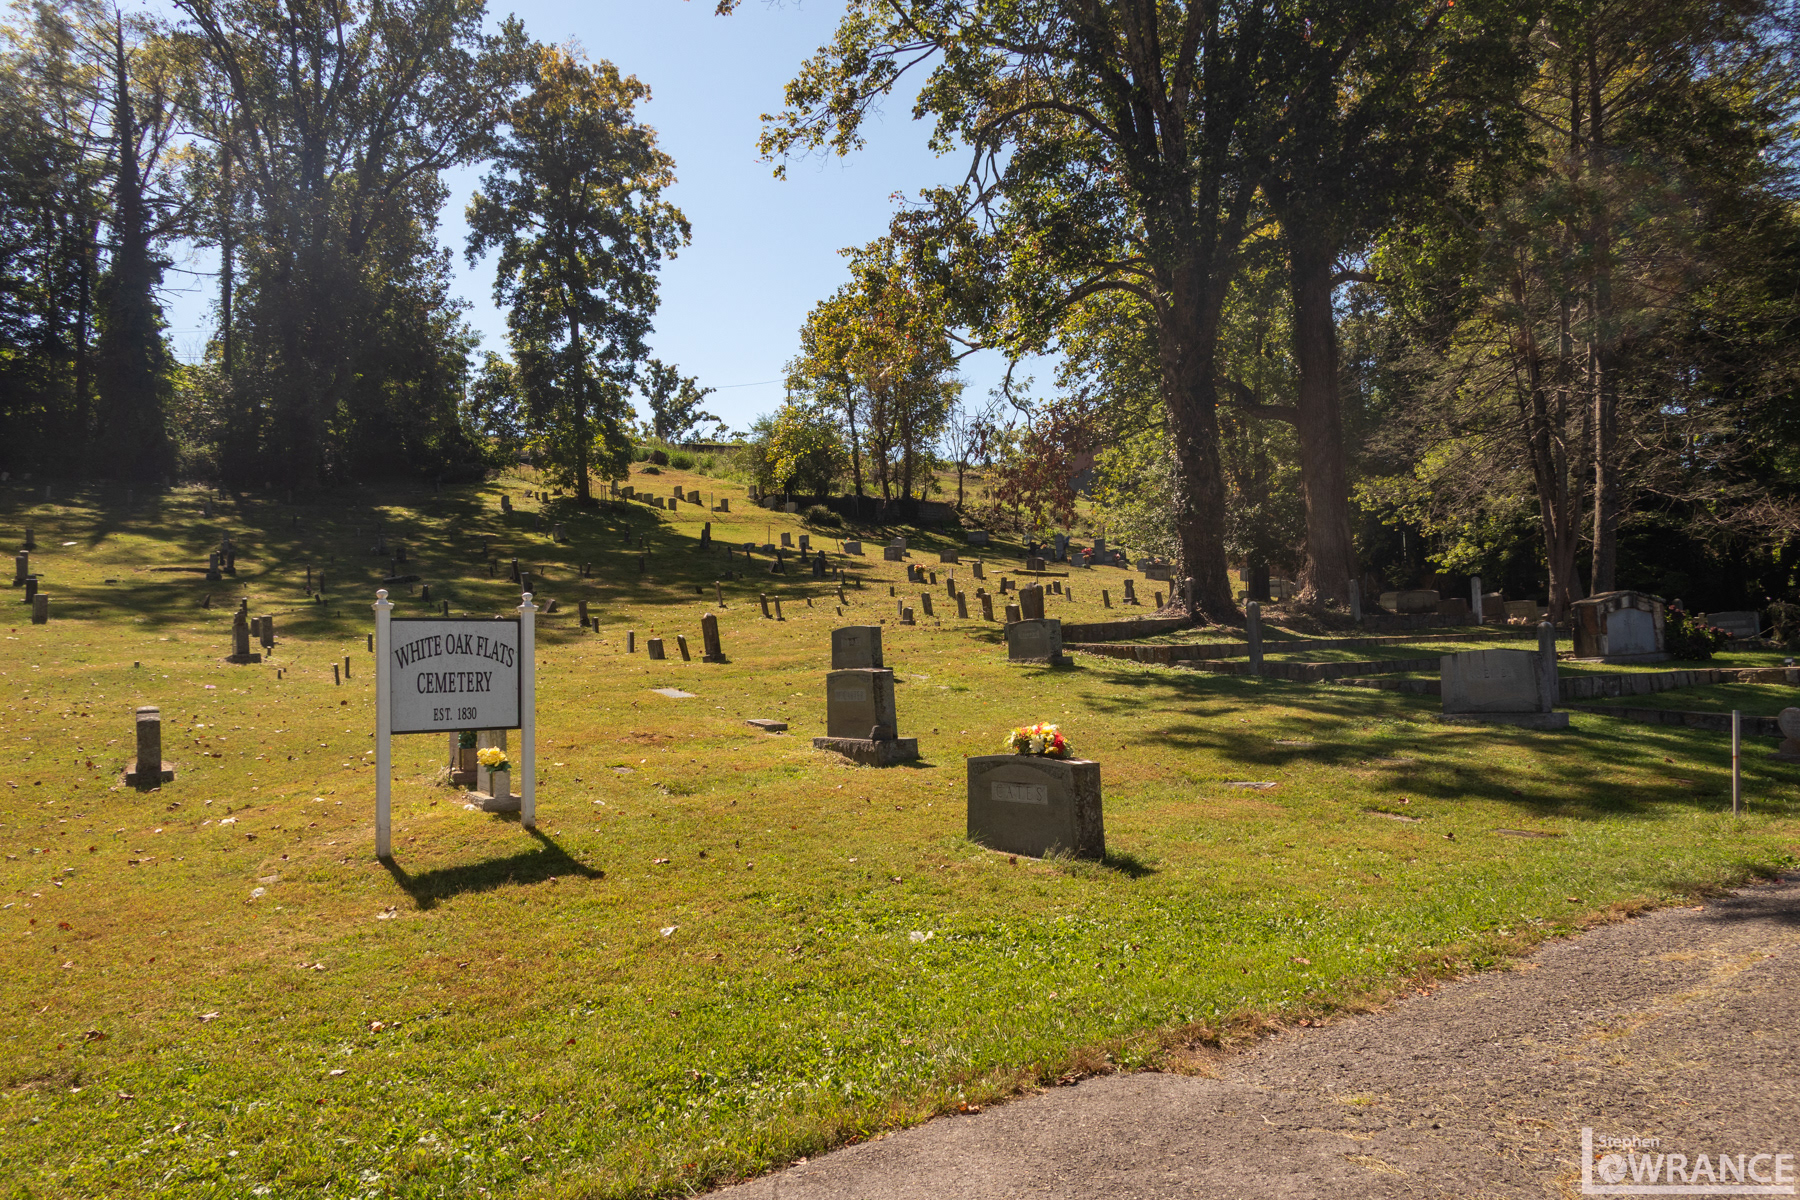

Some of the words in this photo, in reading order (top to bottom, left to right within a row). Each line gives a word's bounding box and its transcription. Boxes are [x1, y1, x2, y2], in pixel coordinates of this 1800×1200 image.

[394, 635, 442, 669] WHITE
[445, 633, 473, 655] OAK
[476, 635, 515, 667] FLATS
[416, 671, 493, 694] CEMETERY
[433, 707, 453, 721] EST.
[457, 706, 477, 720] 1830
[995, 783, 1044, 802] CATES
